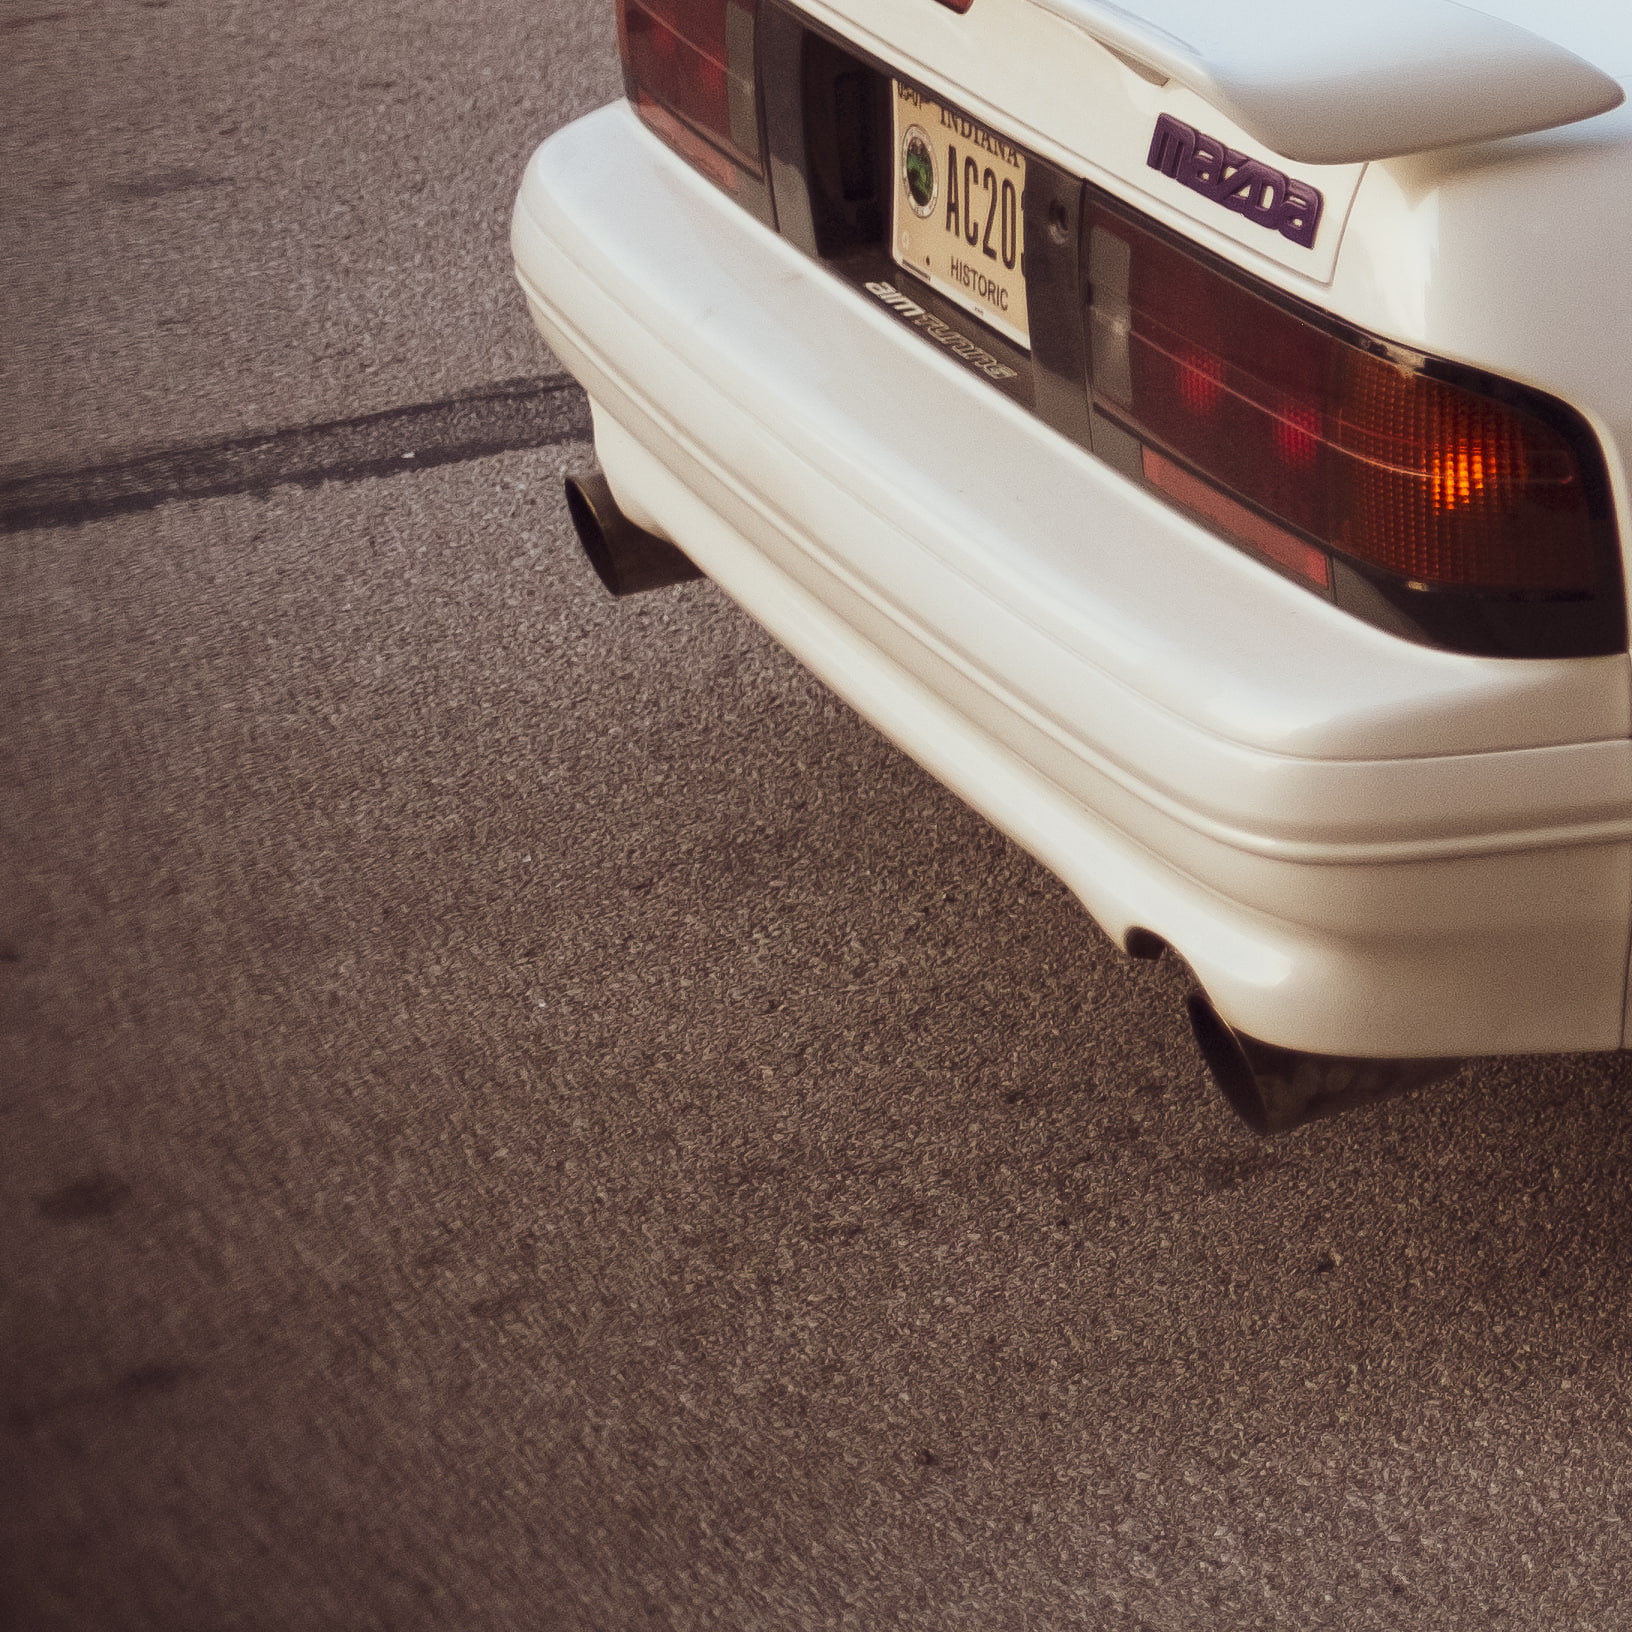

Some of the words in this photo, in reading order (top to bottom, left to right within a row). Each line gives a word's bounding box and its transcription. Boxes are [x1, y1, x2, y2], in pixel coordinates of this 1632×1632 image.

[939, 108, 1021, 169] INDIANA
[1147, 112, 1324, 250] mazda
[945, 143, 1026, 277] AC20
[950, 256, 1009, 312] HISTORIC
